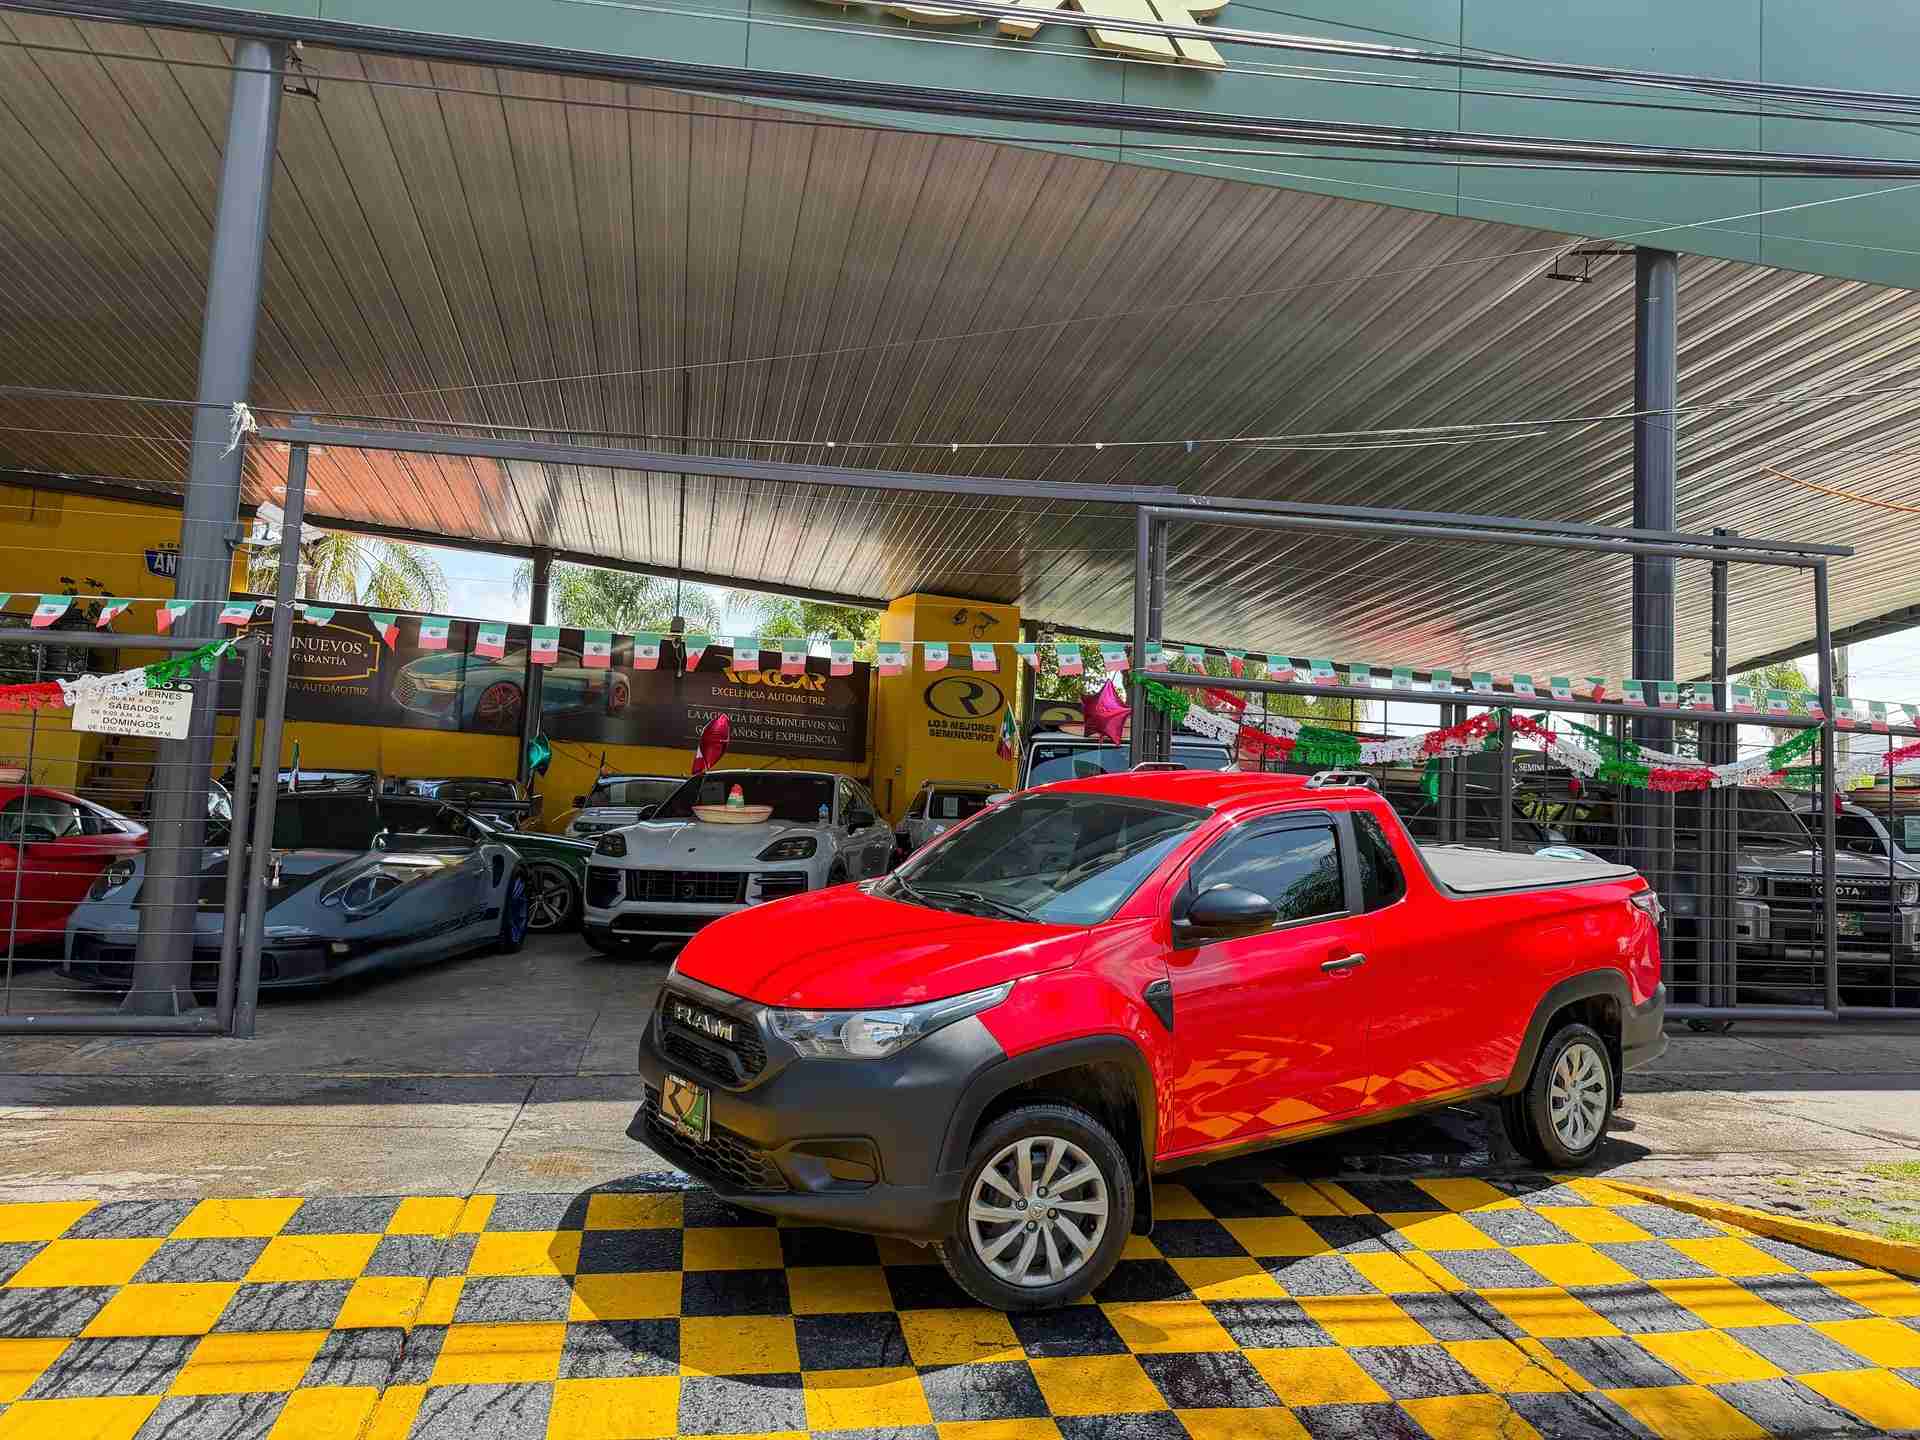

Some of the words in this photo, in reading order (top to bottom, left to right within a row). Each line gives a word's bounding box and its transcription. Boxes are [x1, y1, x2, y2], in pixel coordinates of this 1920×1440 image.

[256, 634, 362, 654] SEINUEVOS
[712, 687, 765, 699] EXCELENCIA
[767, 692, 826, 705] AUTOMOTRIZ
[102, 717, 161, 729] DOMINGOS
[749, 713, 764, 726] DE
[765, 714, 826, 731] SEMINUEVOS
[928, 719, 948, 729] LOS
[950, 720, 996, 733] MEJORES
[732, 725, 758, 739] AÑOS
[761, 728, 774, 741] DE
[776, 730, 838, 745] EXPERIENCIA
[1810, 885, 1860, 896] OOTA
[674, 1005, 733, 1041] RAM
